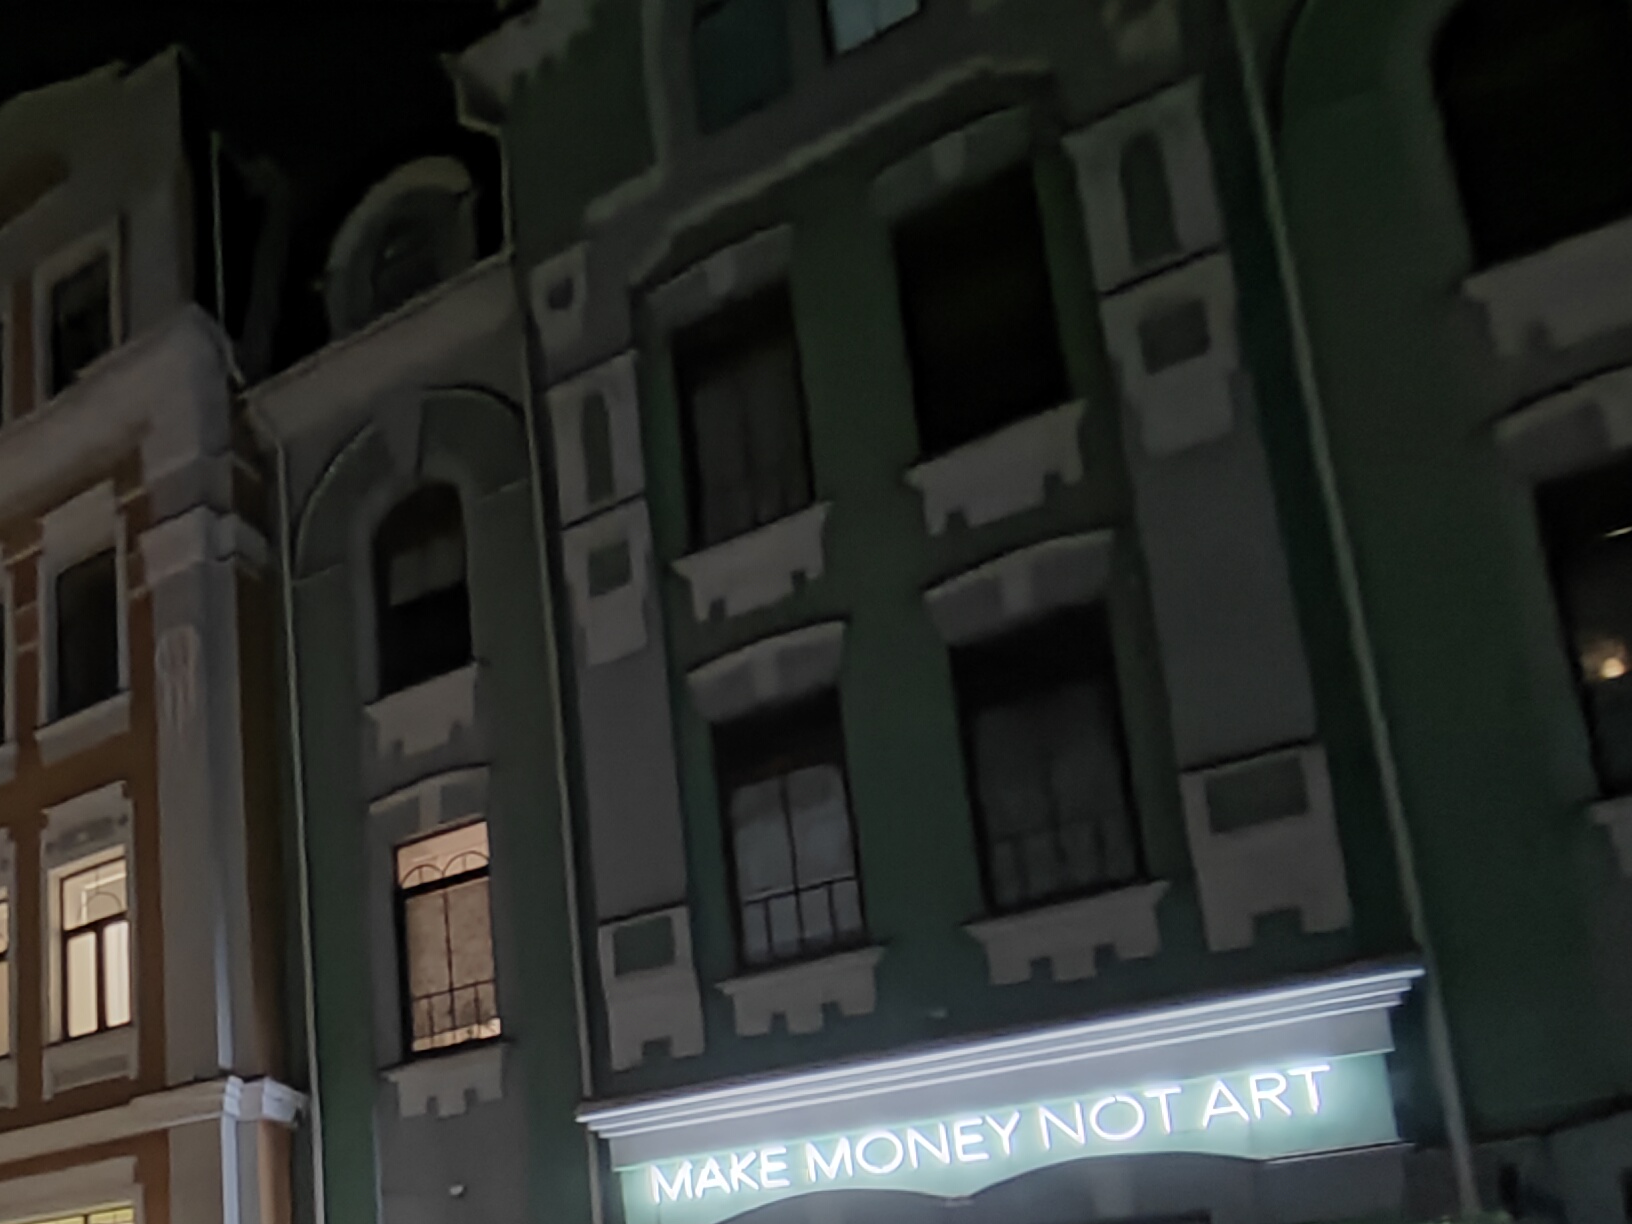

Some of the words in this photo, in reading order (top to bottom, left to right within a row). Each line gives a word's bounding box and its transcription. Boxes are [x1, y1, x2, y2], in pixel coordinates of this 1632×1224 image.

[649, 1145, 791, 1204] MAKE
[805, 1110, 1021, 1183] MONEY
[1038, 1085, 1182, 1150] NOT
[1201, 1063, 1331, 1129] ART
